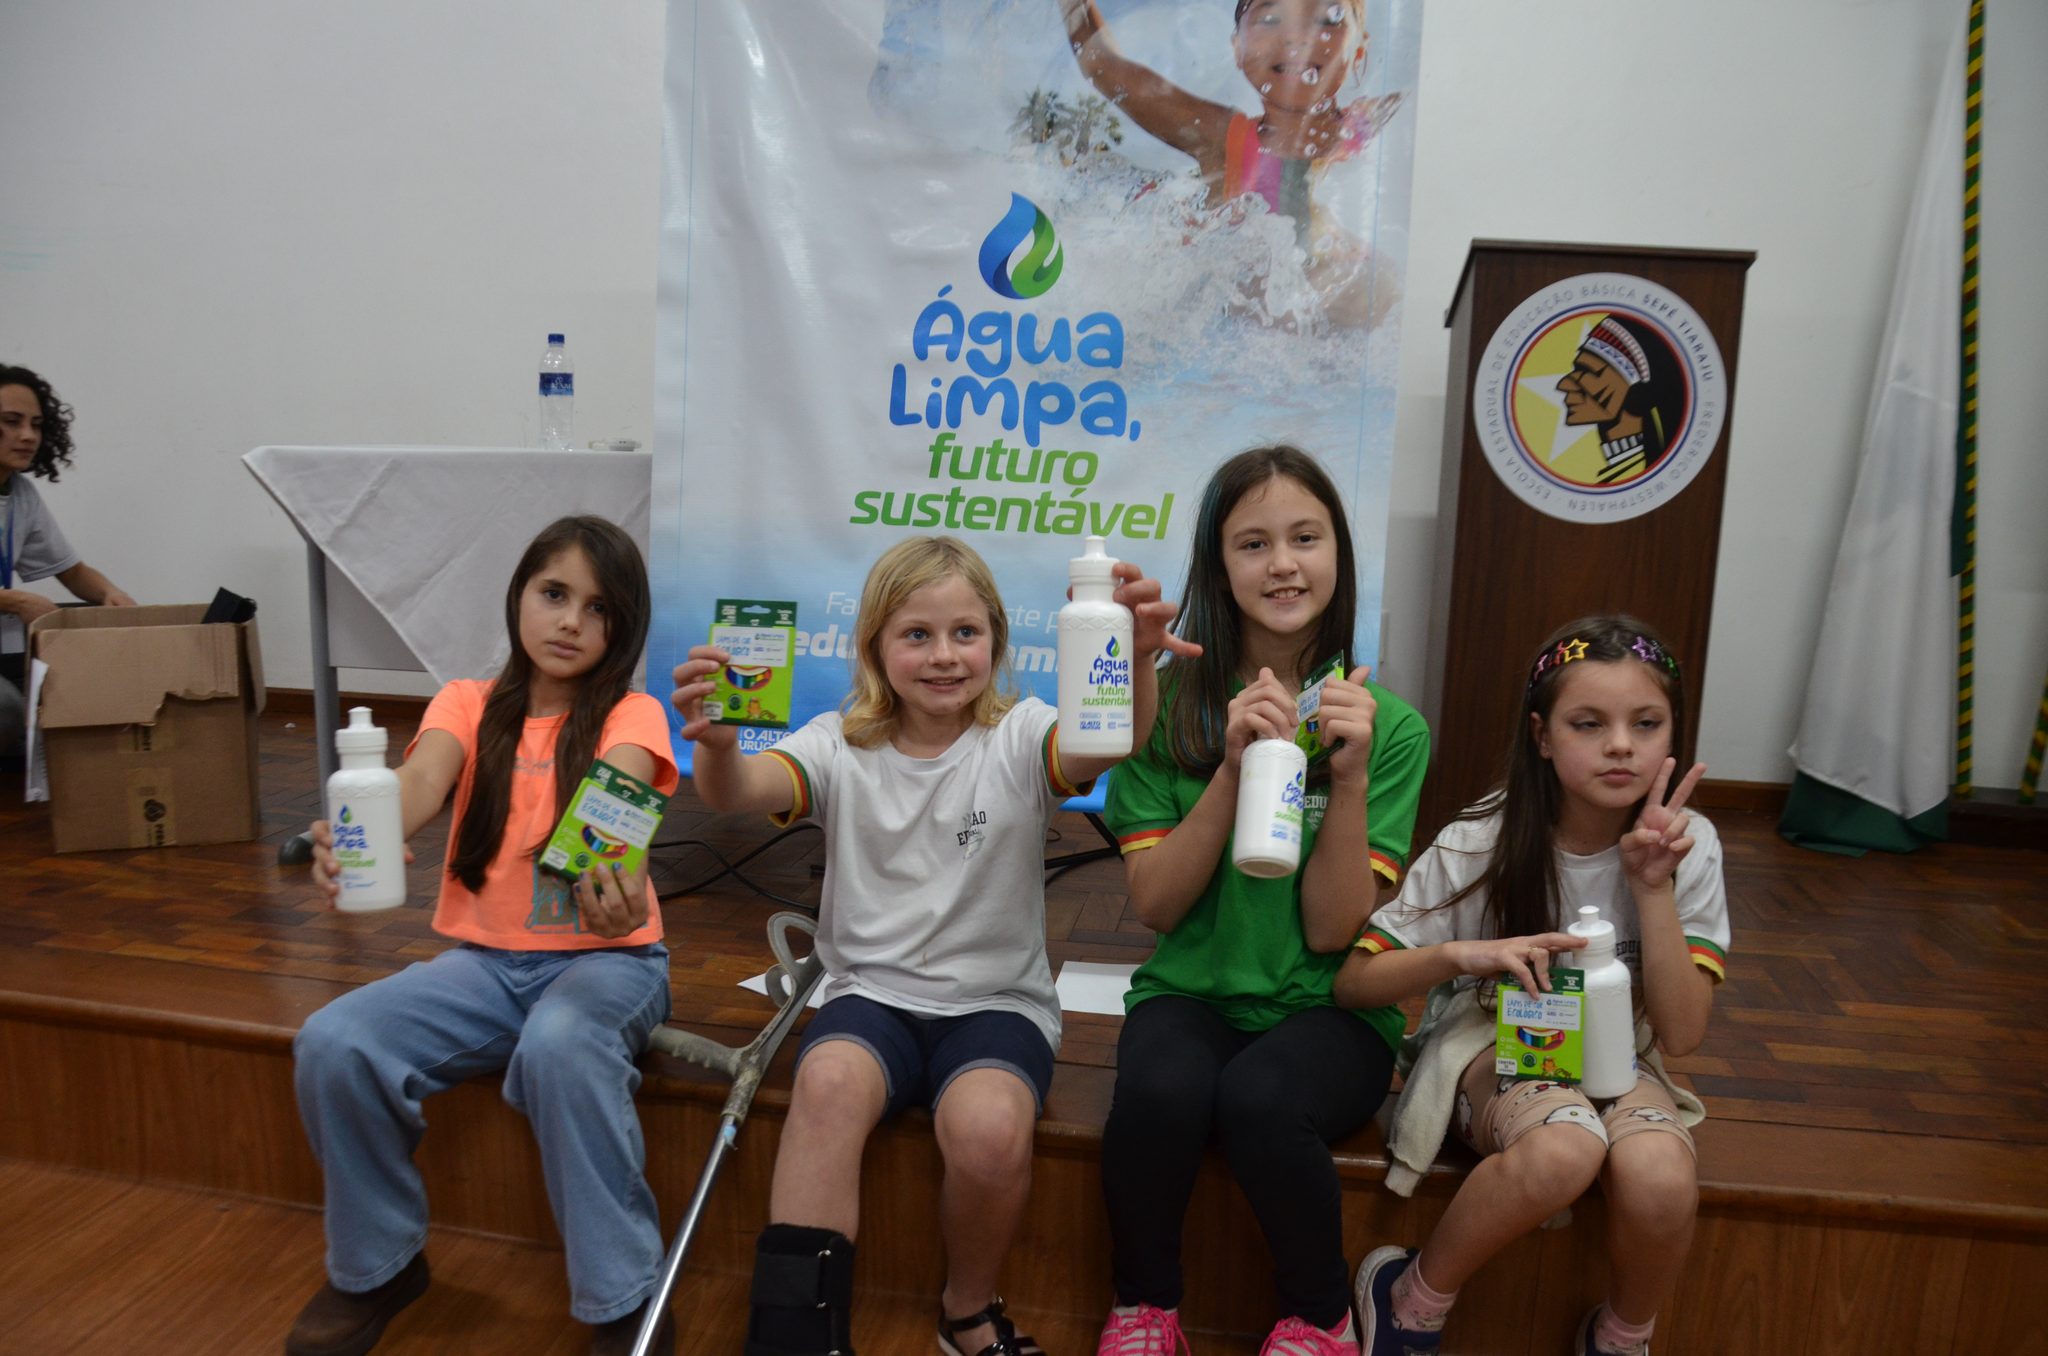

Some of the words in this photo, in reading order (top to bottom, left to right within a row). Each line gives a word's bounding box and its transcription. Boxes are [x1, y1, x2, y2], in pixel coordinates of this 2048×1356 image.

[913, 284, 1124, 378] Água
[1679, 320, 1714, 382] TIARAJU
[1492, 352, 1507, 371] DE
[889, 363, 1141, 448] Limpa,
[1487, 379, 1508, 454] ESTADUAL
[928, 432, 1098, 486] futuro
[1504, 457, 1552, 500] ESCOLA
[849, 486, 1175, 540] sustentável
[1093, 654, 1129, 674] Água
